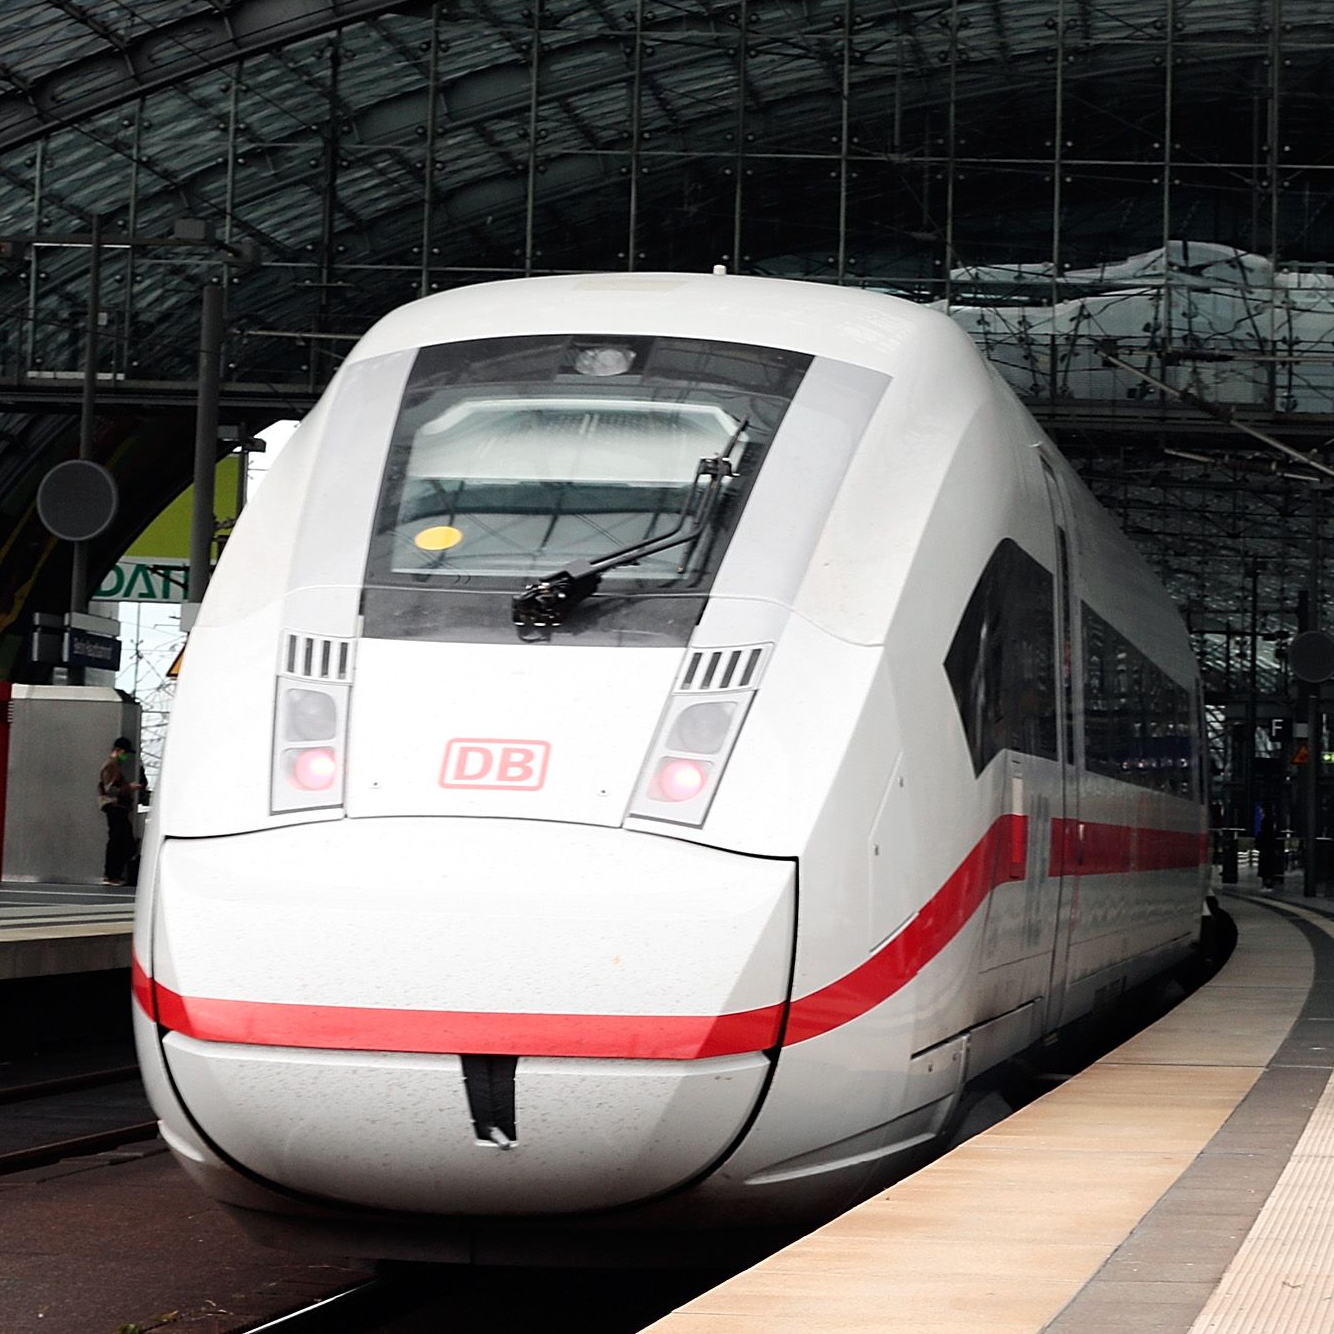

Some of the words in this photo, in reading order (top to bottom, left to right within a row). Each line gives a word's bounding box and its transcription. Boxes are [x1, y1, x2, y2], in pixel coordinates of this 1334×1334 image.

[94, 564, 189, 600] DAT
[1272, 719, 1284, 737] F
[451, 746, 534, 782] DB
